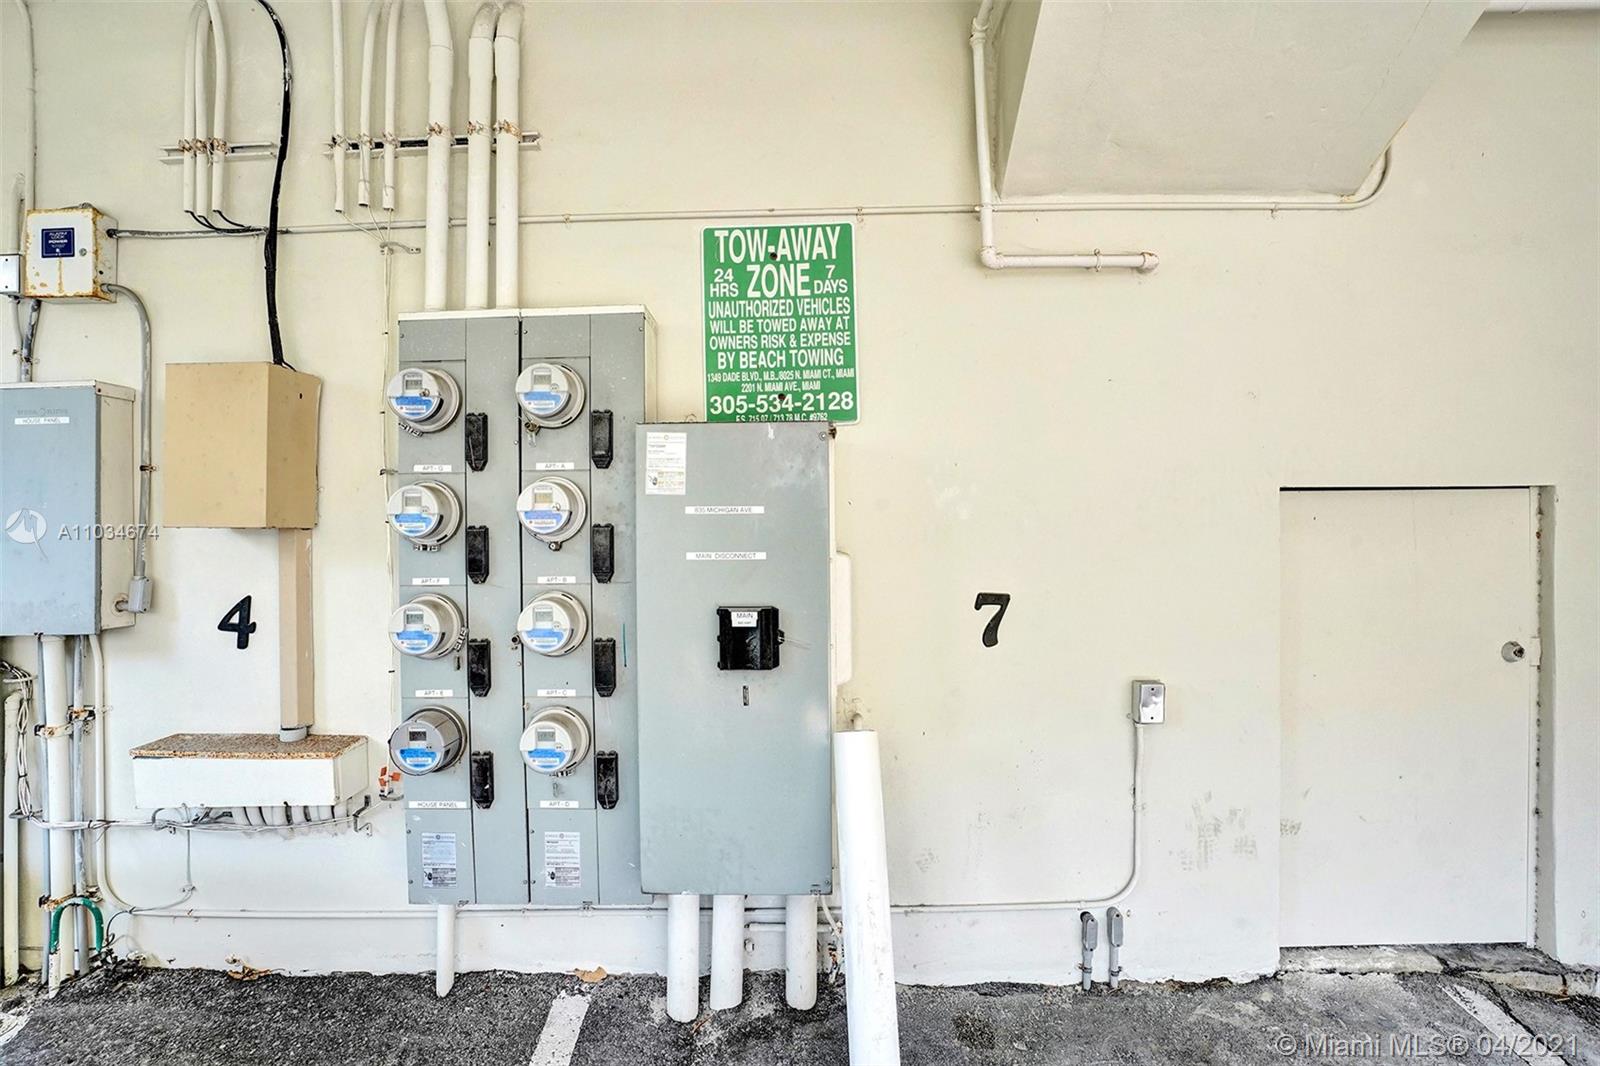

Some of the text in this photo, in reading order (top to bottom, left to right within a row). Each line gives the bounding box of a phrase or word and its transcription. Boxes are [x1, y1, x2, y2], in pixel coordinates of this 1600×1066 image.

[714, 226, 841, 263] TOW-AWAY
[714, 268, 734, 283] 24
[746, 263, 811, 298] ZONE
[825, 265, 836, 278] 7
[710, 283, 739, 298] HRS
[814, 279, 848, 294] DAYS
[708, 297, 850, 318] UNAUTHORIZED VEHICLES
[710, 316, 850, 334] WILL BE TOWED AWAY AT
[710, 332, 851, 350] OWNERS RISK & EXPENSE
[718, 348, 844, 369] BY BEACH TOWING
[708, 372, 722, 382] 1349
[722, 372, 740, 382] DADE
[802, 368, 822, 379] MIAMI
[836, 368, 854, 378] MIAMI
[764, 382, 784, 392] MIAMI
[802, 380, 820, 390] MIAMI
[710, 391, 854, 415] 305-534-2128
[218, 594, 256, 650] 4
[974, 592, 1010, 648] 7
